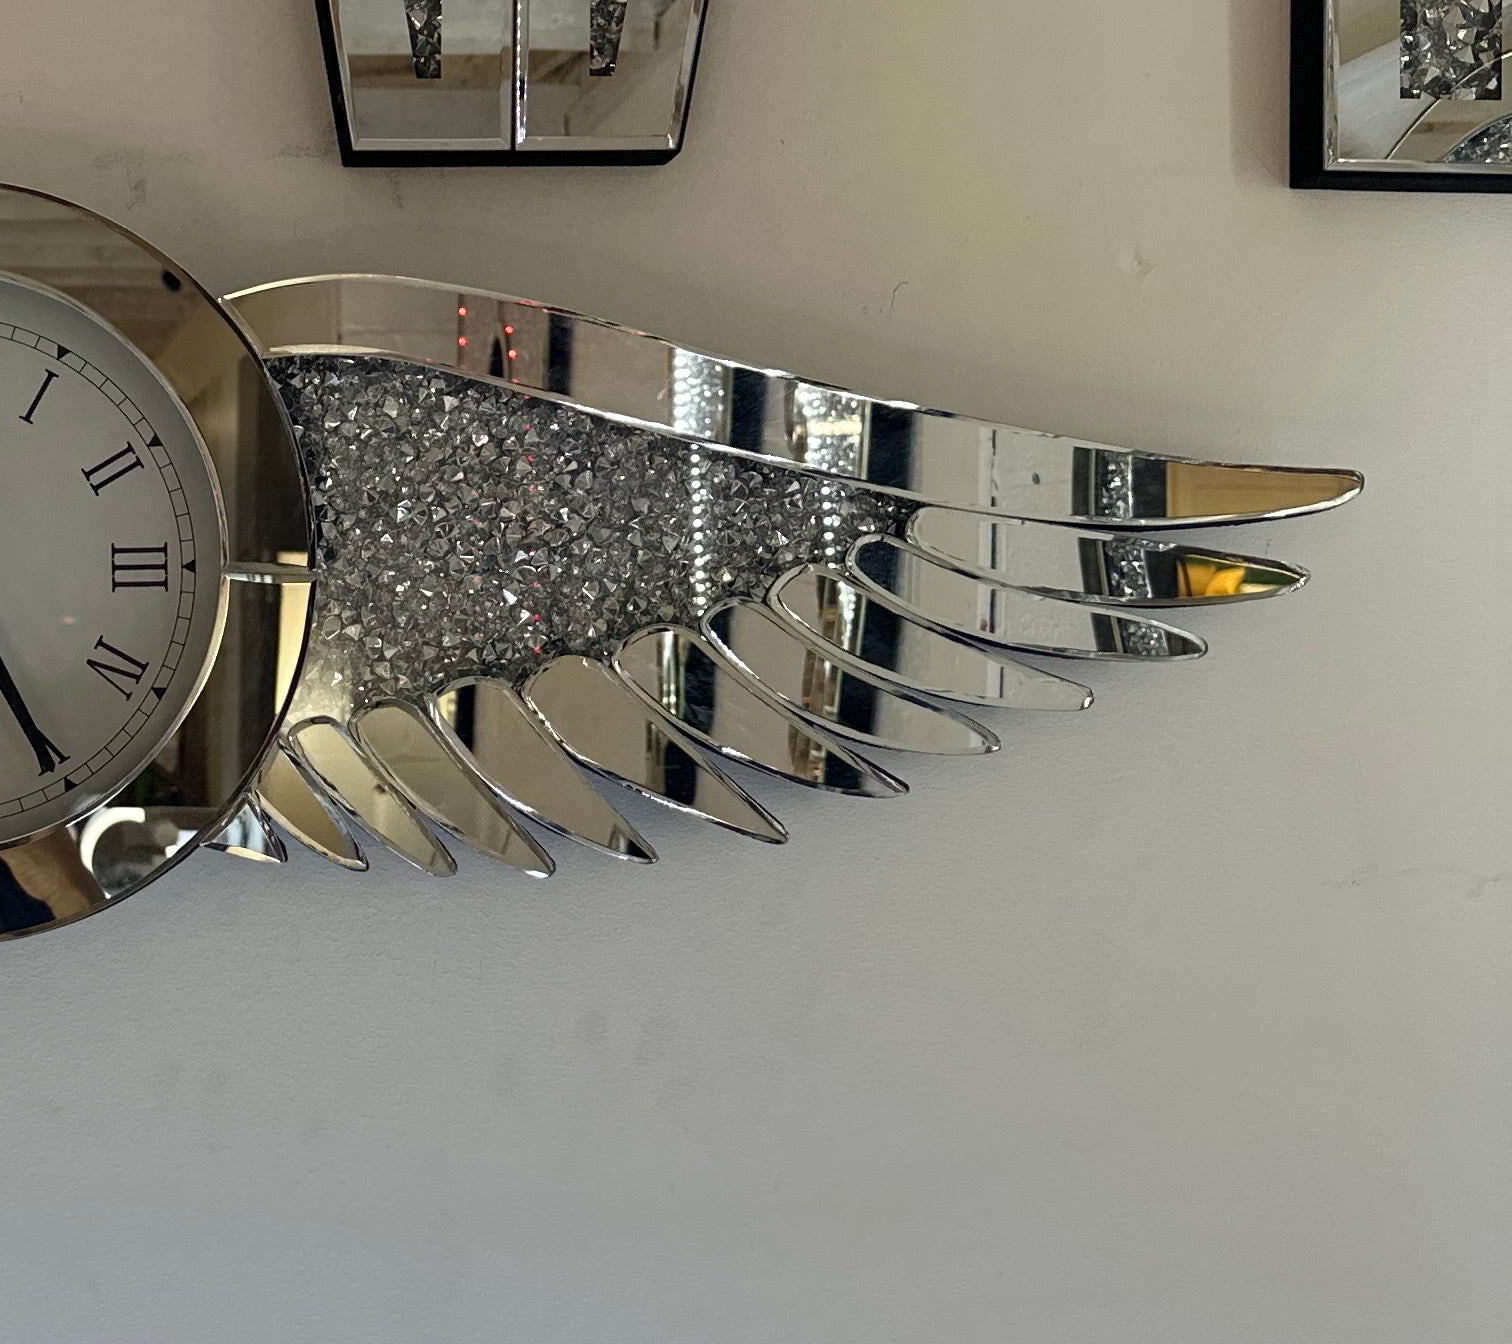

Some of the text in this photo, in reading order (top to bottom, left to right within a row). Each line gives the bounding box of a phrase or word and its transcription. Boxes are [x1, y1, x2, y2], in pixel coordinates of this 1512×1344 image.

[19, 368, 59, 425] I
[81, 441, 144, 496] II
[111, 542, 169, 593] III
[86, 635, 149, 701] IV
